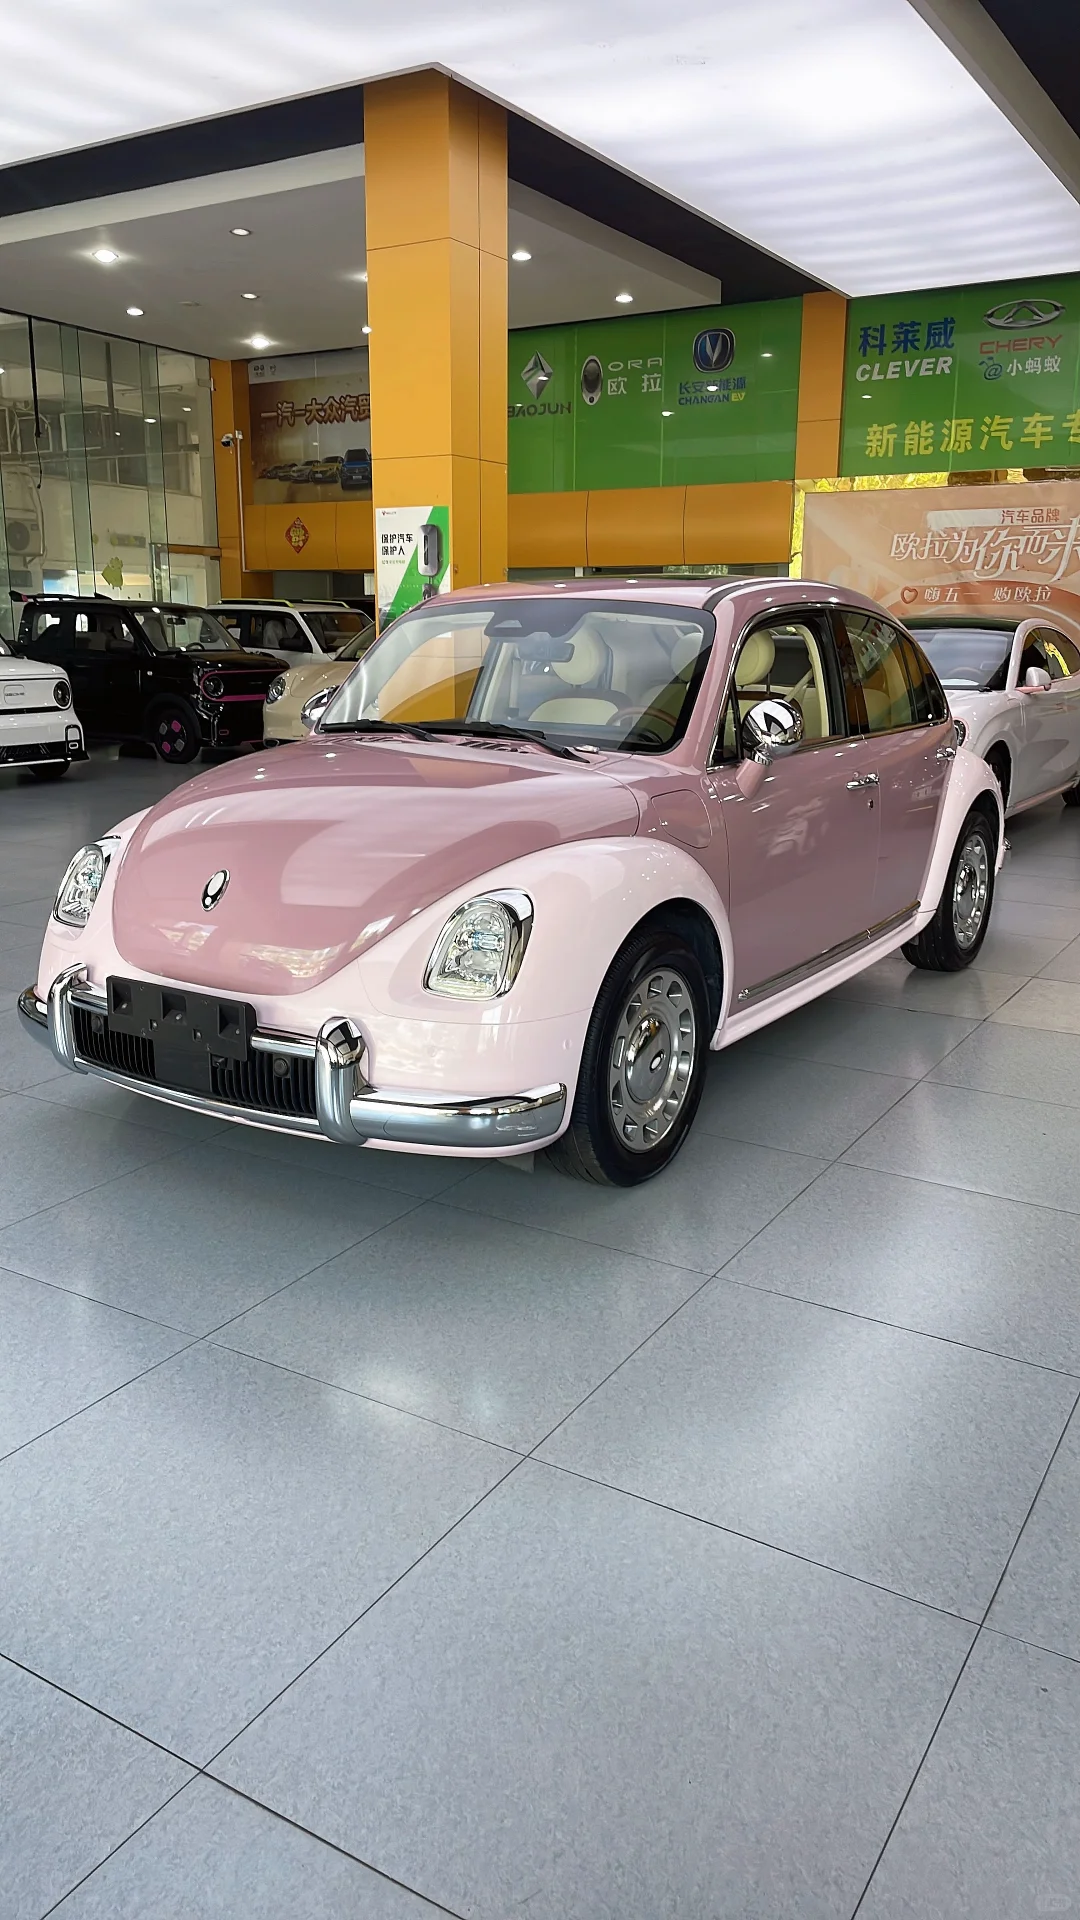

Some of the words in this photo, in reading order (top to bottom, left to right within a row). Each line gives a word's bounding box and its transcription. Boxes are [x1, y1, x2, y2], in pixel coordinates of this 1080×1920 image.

[858, 317, 956, 357] 科莱威
[979, 334, 1063, 355] CHERY
[607, 357, 663, 372] ORA
[856, 357, 953, 382] CLEVER
[1006, 355, 1062, 377] 小蚂蚁
[607, 373, 662, 395] 欧拉
[678, 394, 730, 406] CHANGAN
[731, 392, 746, 402] EV
[1001, 508, 1060, 524] 汽车品牌
[993, 585, 1052, 602] 购欧拉
